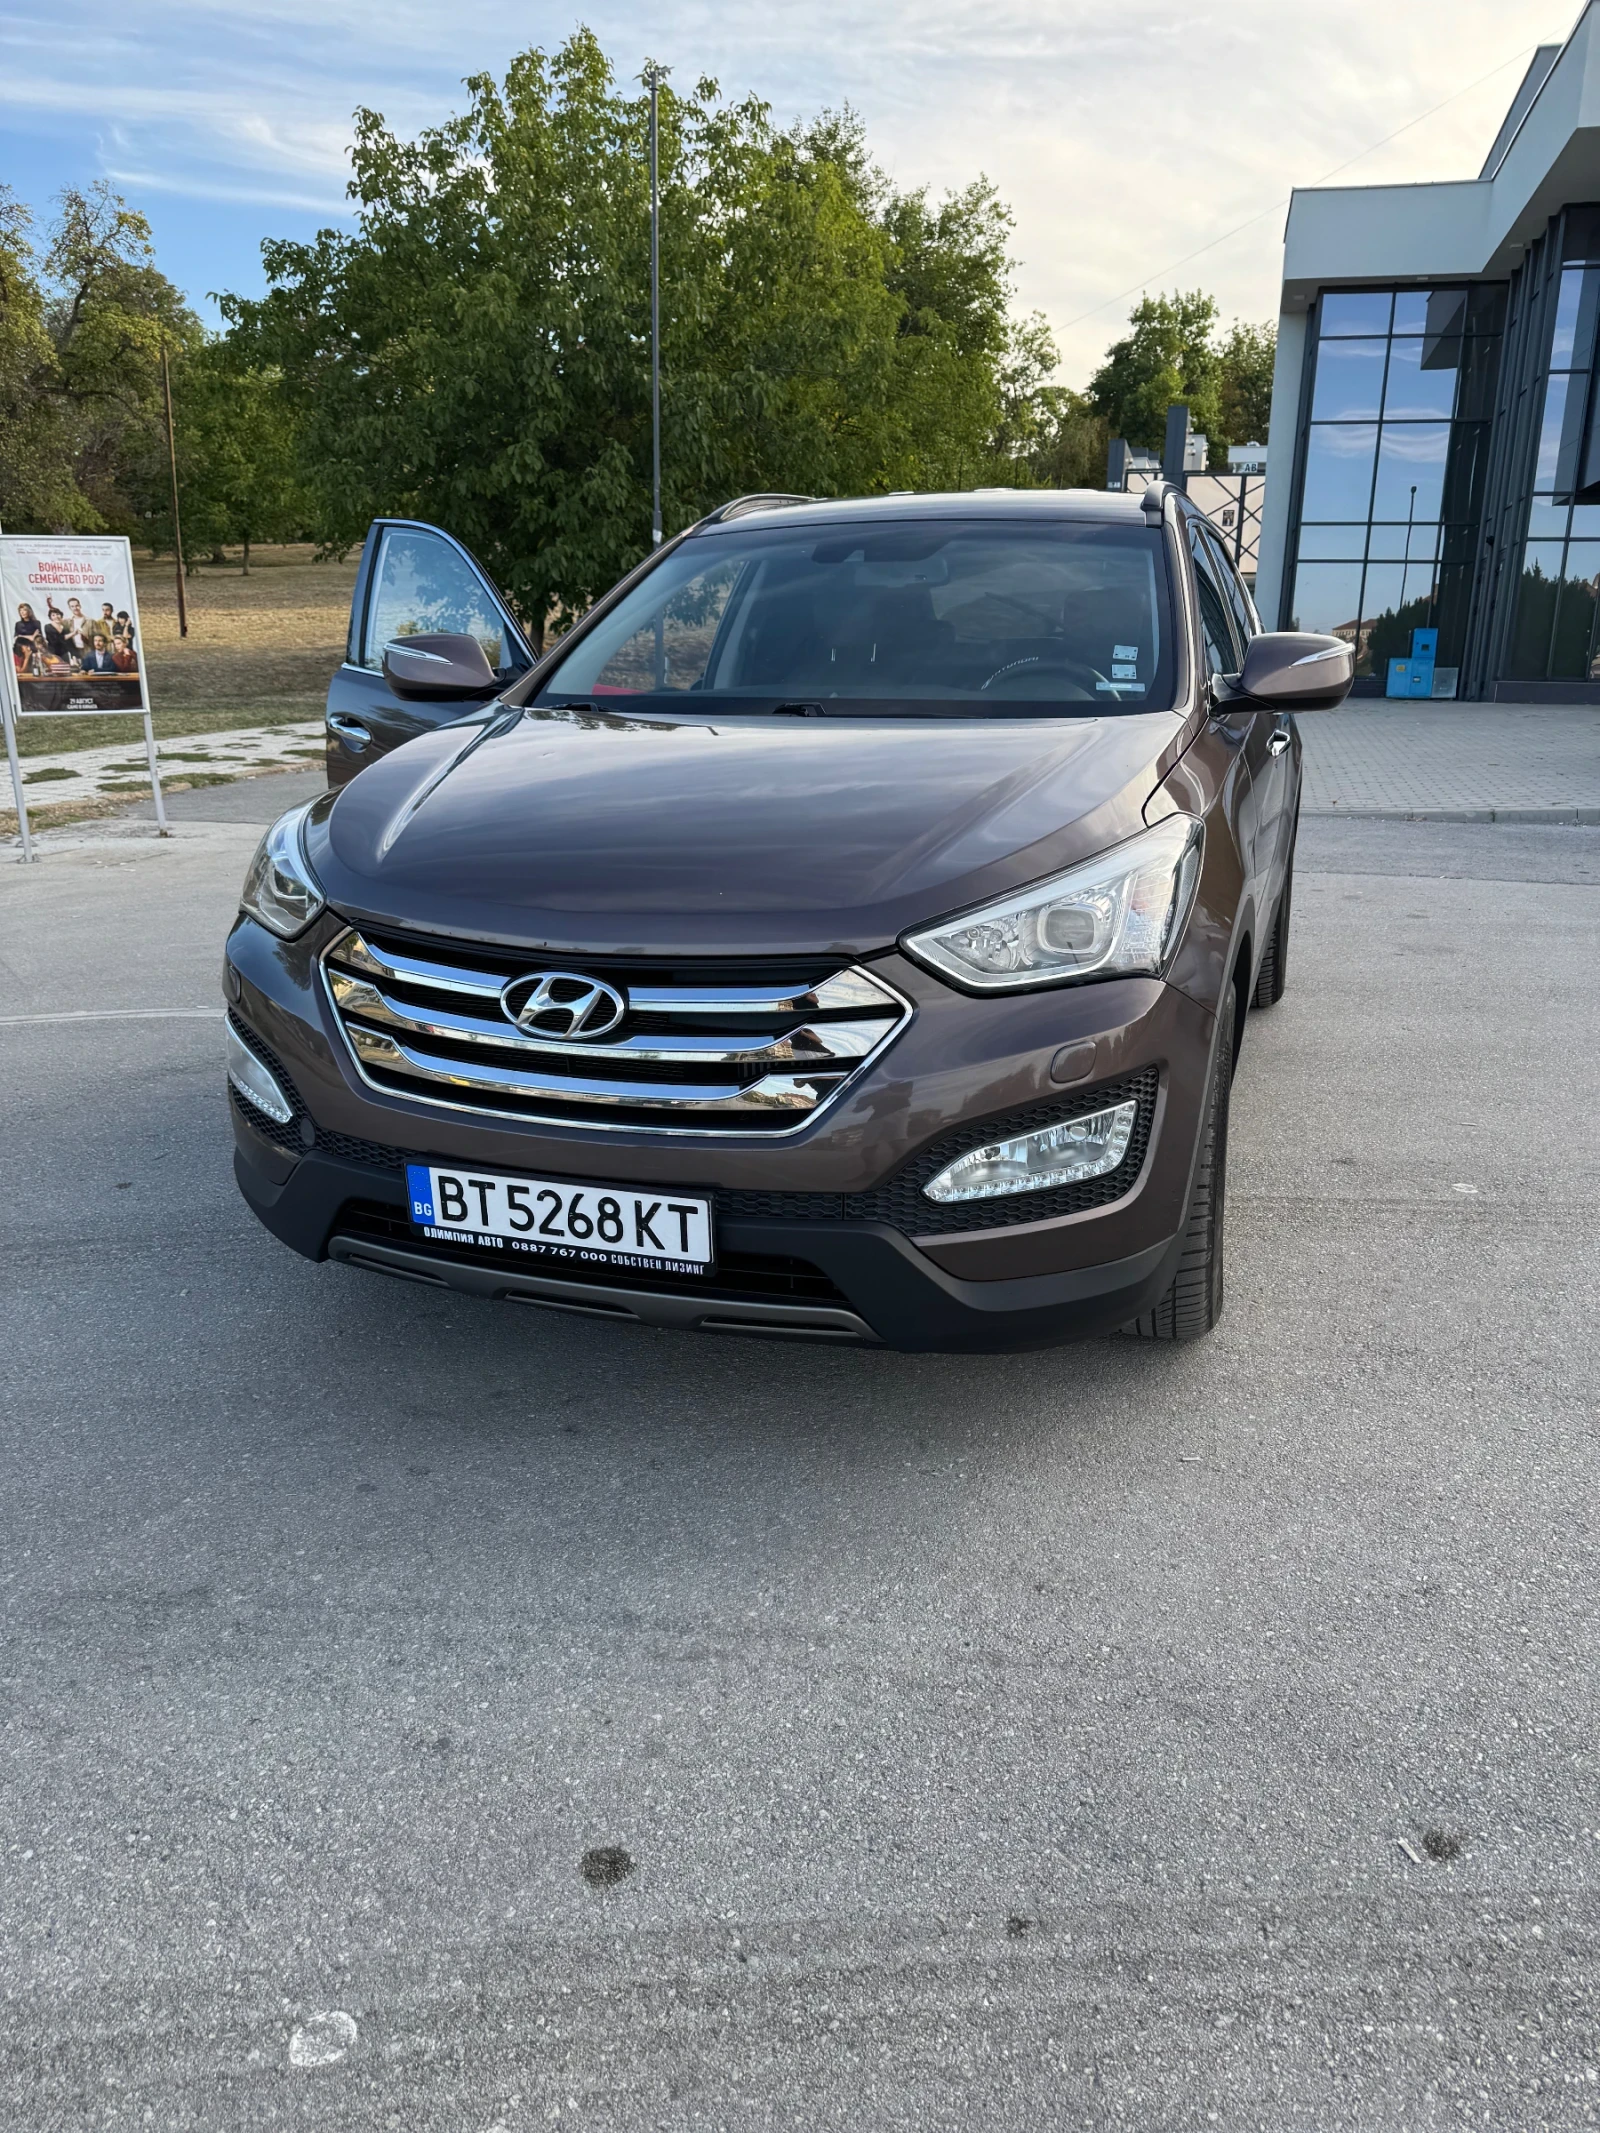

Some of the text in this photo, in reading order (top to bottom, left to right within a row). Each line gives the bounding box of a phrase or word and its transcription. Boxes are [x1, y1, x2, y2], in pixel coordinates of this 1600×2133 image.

[38, 561, 93, 573] ВОЙНАТА НА
[28, 573, 105, 585] СЕМЕЙСТВО РОУЗ
[413, 1201, 432, 1216] BG
[438, 1175, 698, 1253] BT 5268 KT
[423, 1226, 706, 1275] ОЛИМПИЯ АВТО 0887 767 000 СОБСТВЕН ЛИЗИНГ
